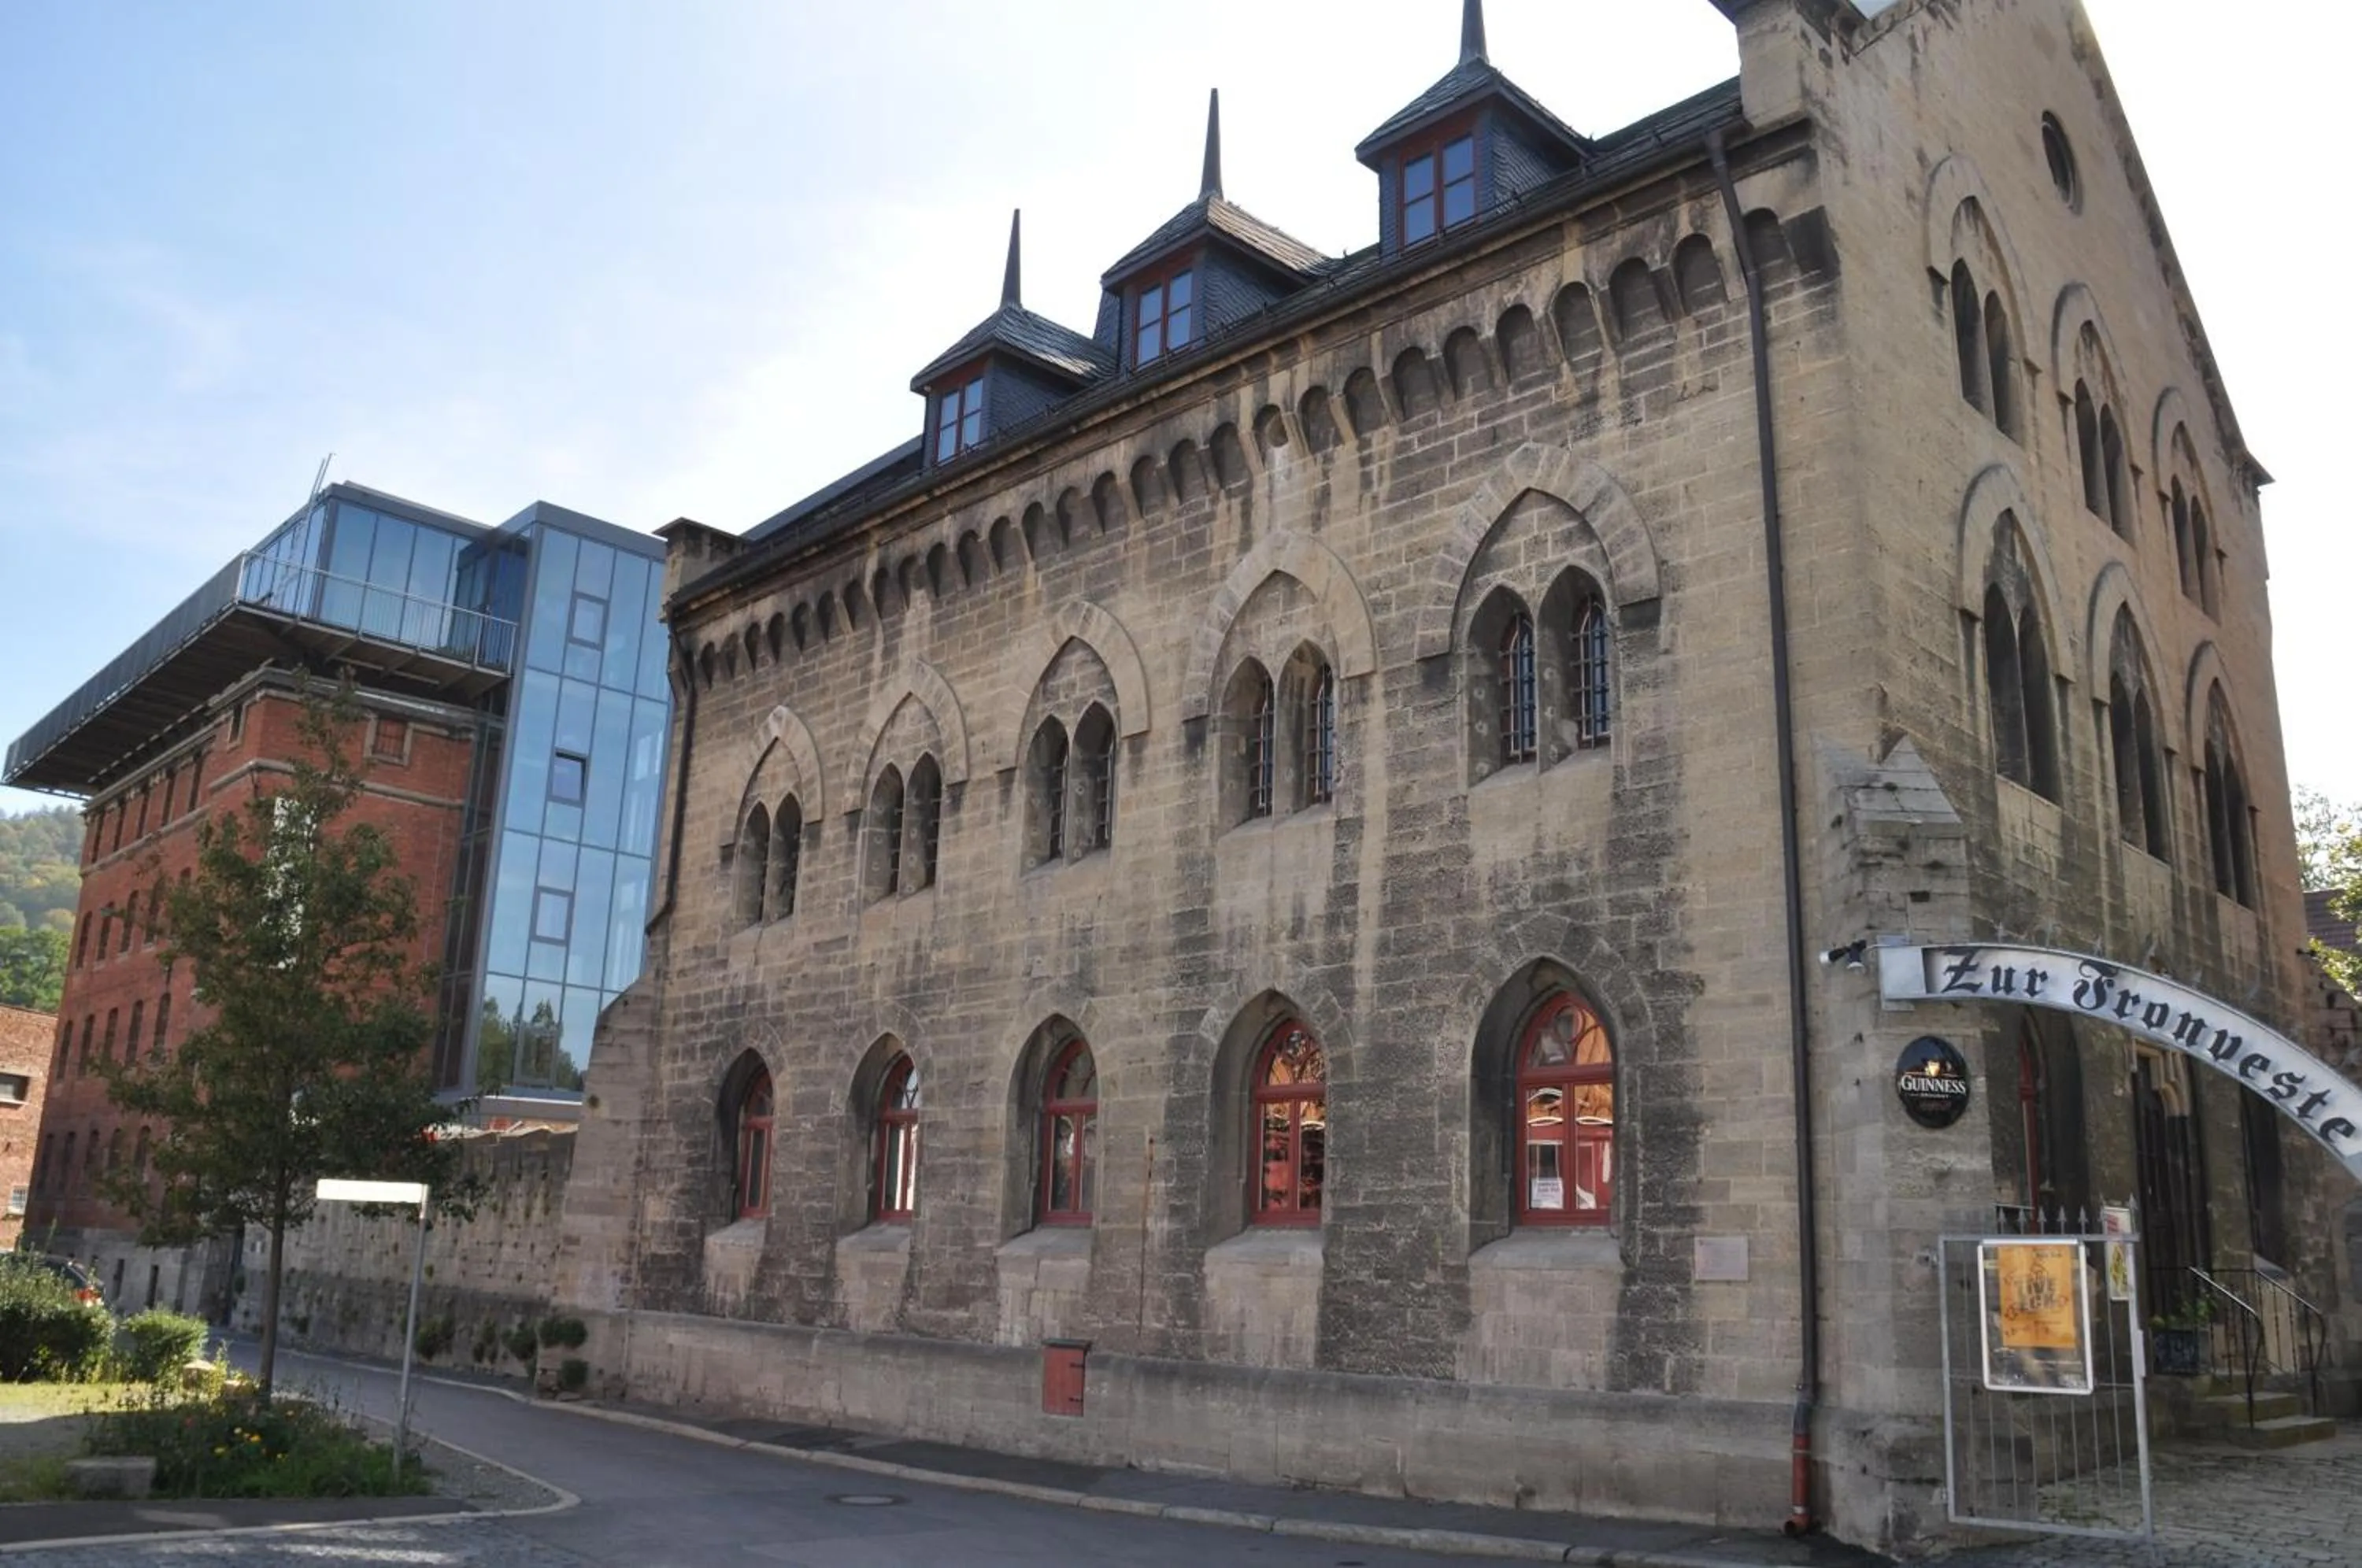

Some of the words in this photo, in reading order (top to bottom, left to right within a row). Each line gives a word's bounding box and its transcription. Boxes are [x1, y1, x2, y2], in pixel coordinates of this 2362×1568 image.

[1901, 1074, 1967, 1096] GUINNESS
[1941, 945, 2049, 997] Zur
[2073, 960, 2356, 1142] Fronveste
